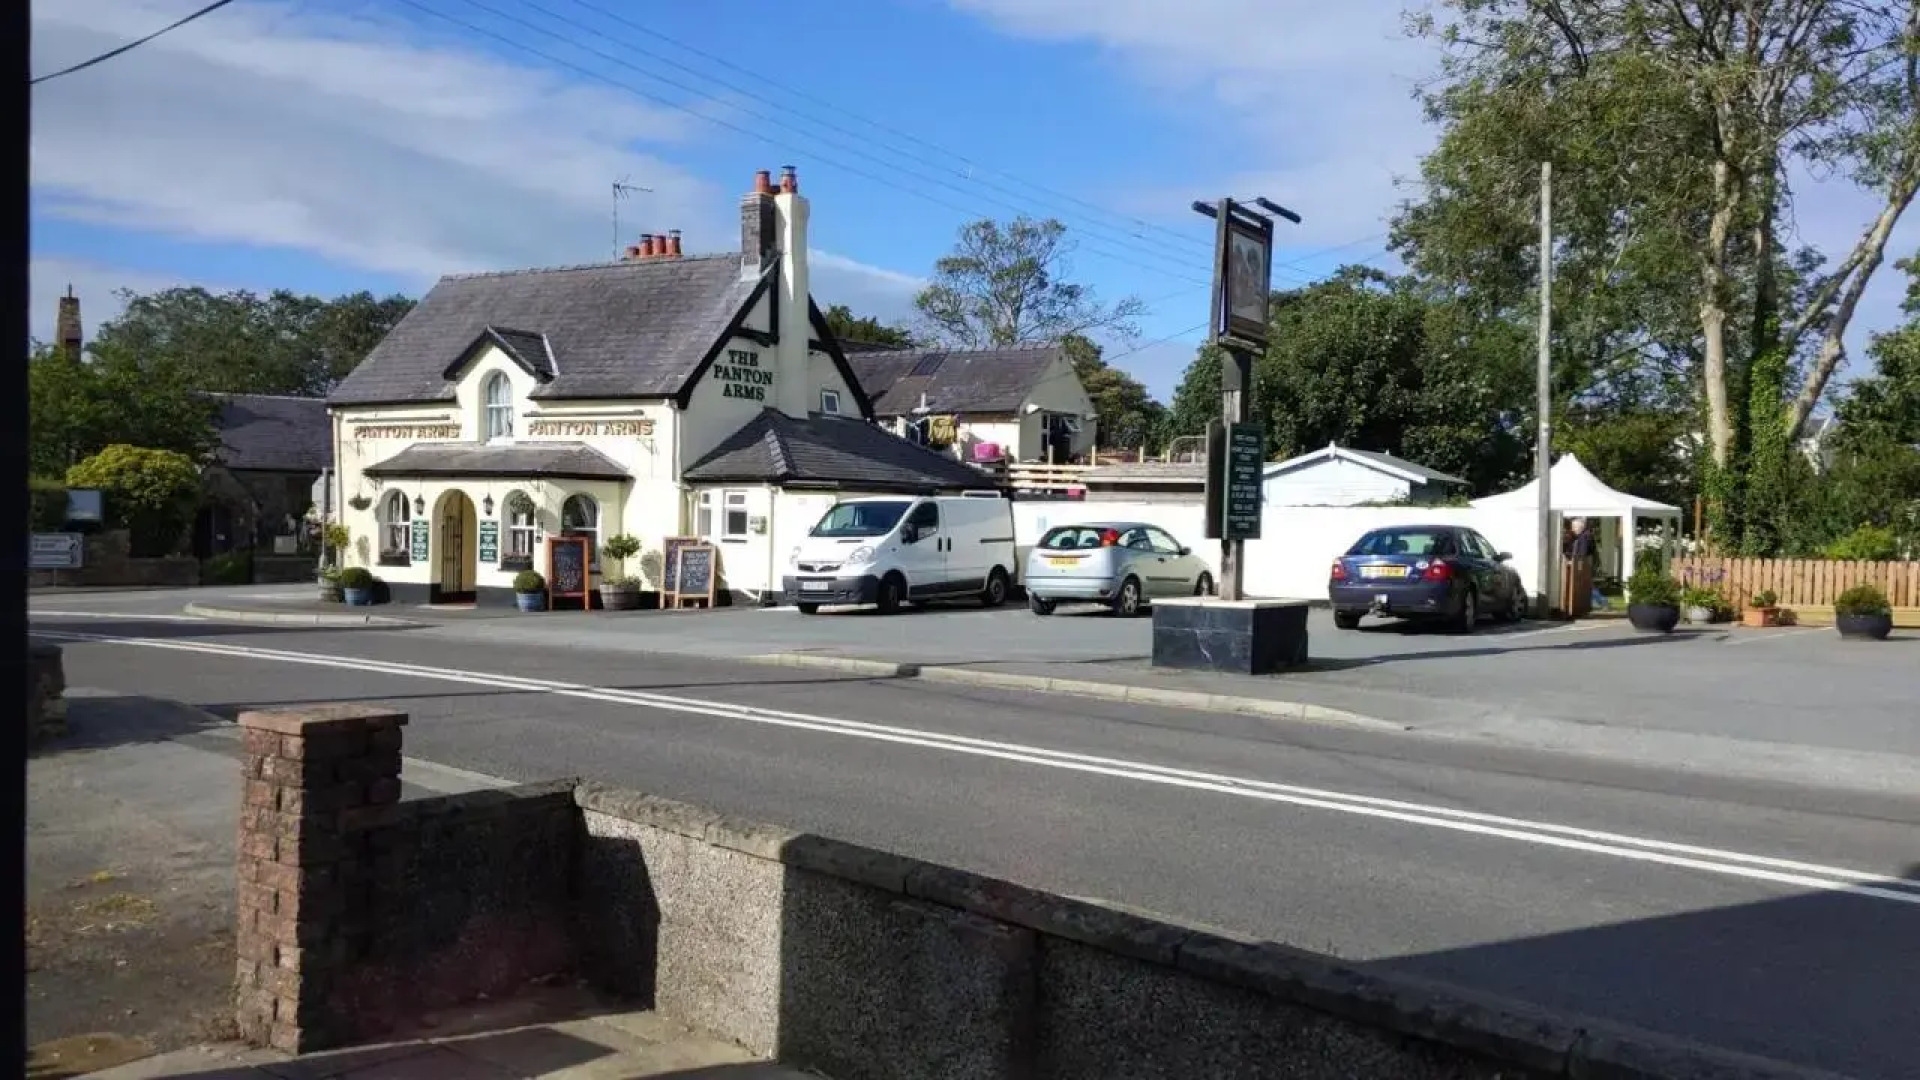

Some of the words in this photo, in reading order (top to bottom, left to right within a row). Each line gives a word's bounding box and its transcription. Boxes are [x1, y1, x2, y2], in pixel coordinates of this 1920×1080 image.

[728, 350, 758, 366] THE
[714, 364, 773, 385] PANTON
[723, 384, 765, 402] ARMS
[354, 424, 413, 439] PANTON
[416, 424, 460, 438] ARMS
[528, 420, 598, 436] PANTON
[602, 419, 654, 436] ARMS
